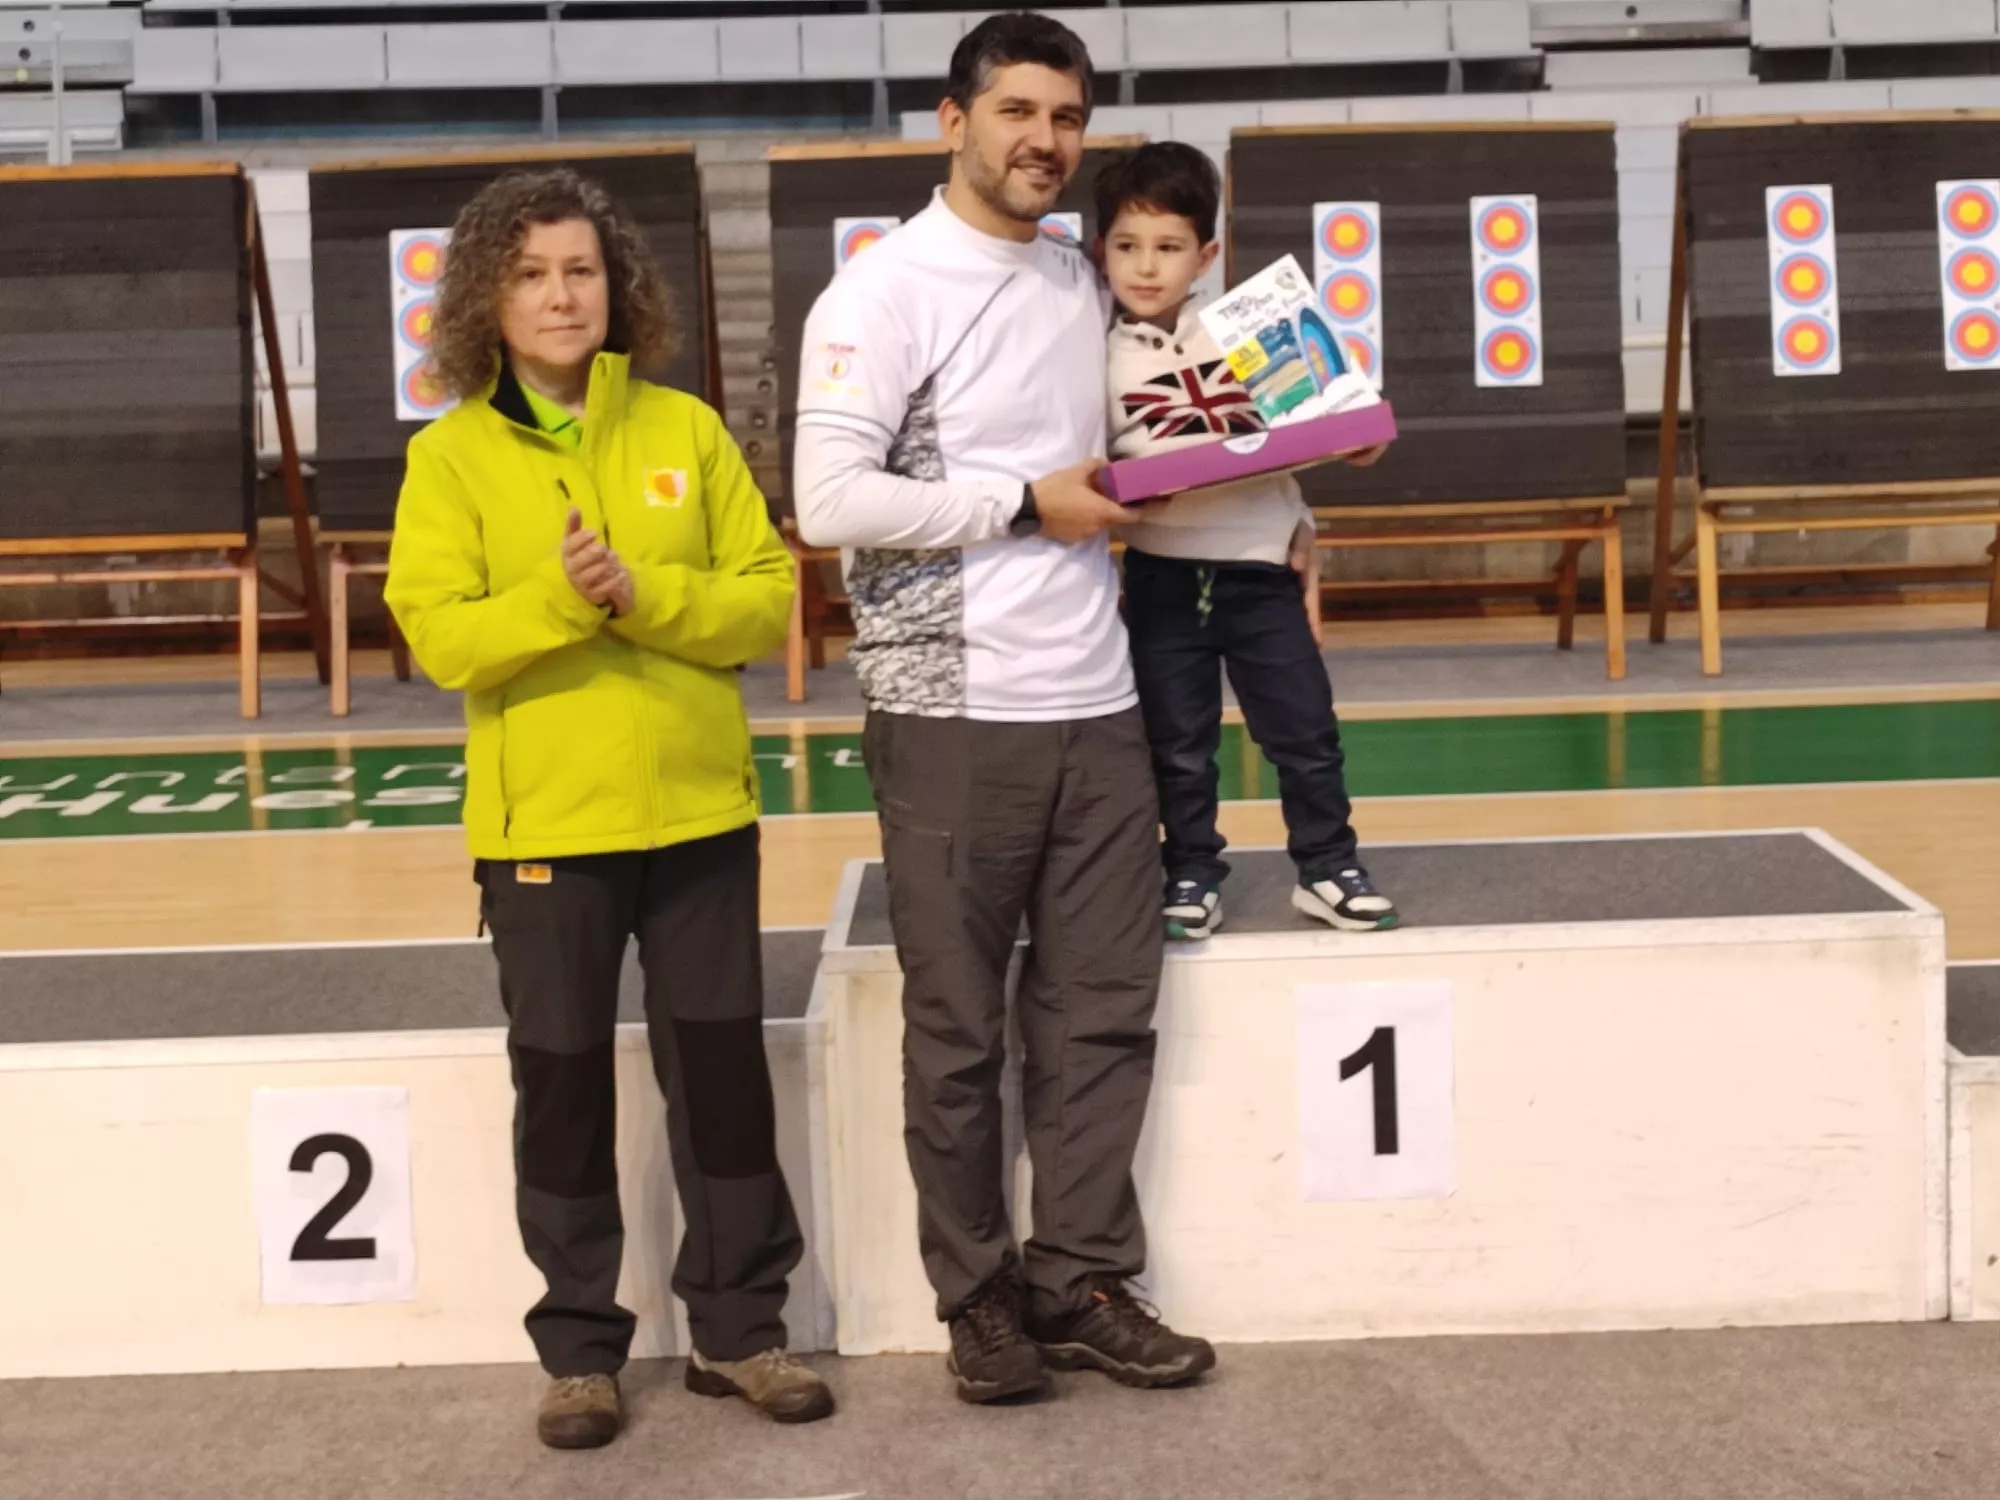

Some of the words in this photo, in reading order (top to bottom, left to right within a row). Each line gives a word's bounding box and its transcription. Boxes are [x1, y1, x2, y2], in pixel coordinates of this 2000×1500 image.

[0, 786, 463, 818] Hues
[1339, 1026, 1399, 1155] 1
[288, 1133, 376, 1261] 2
